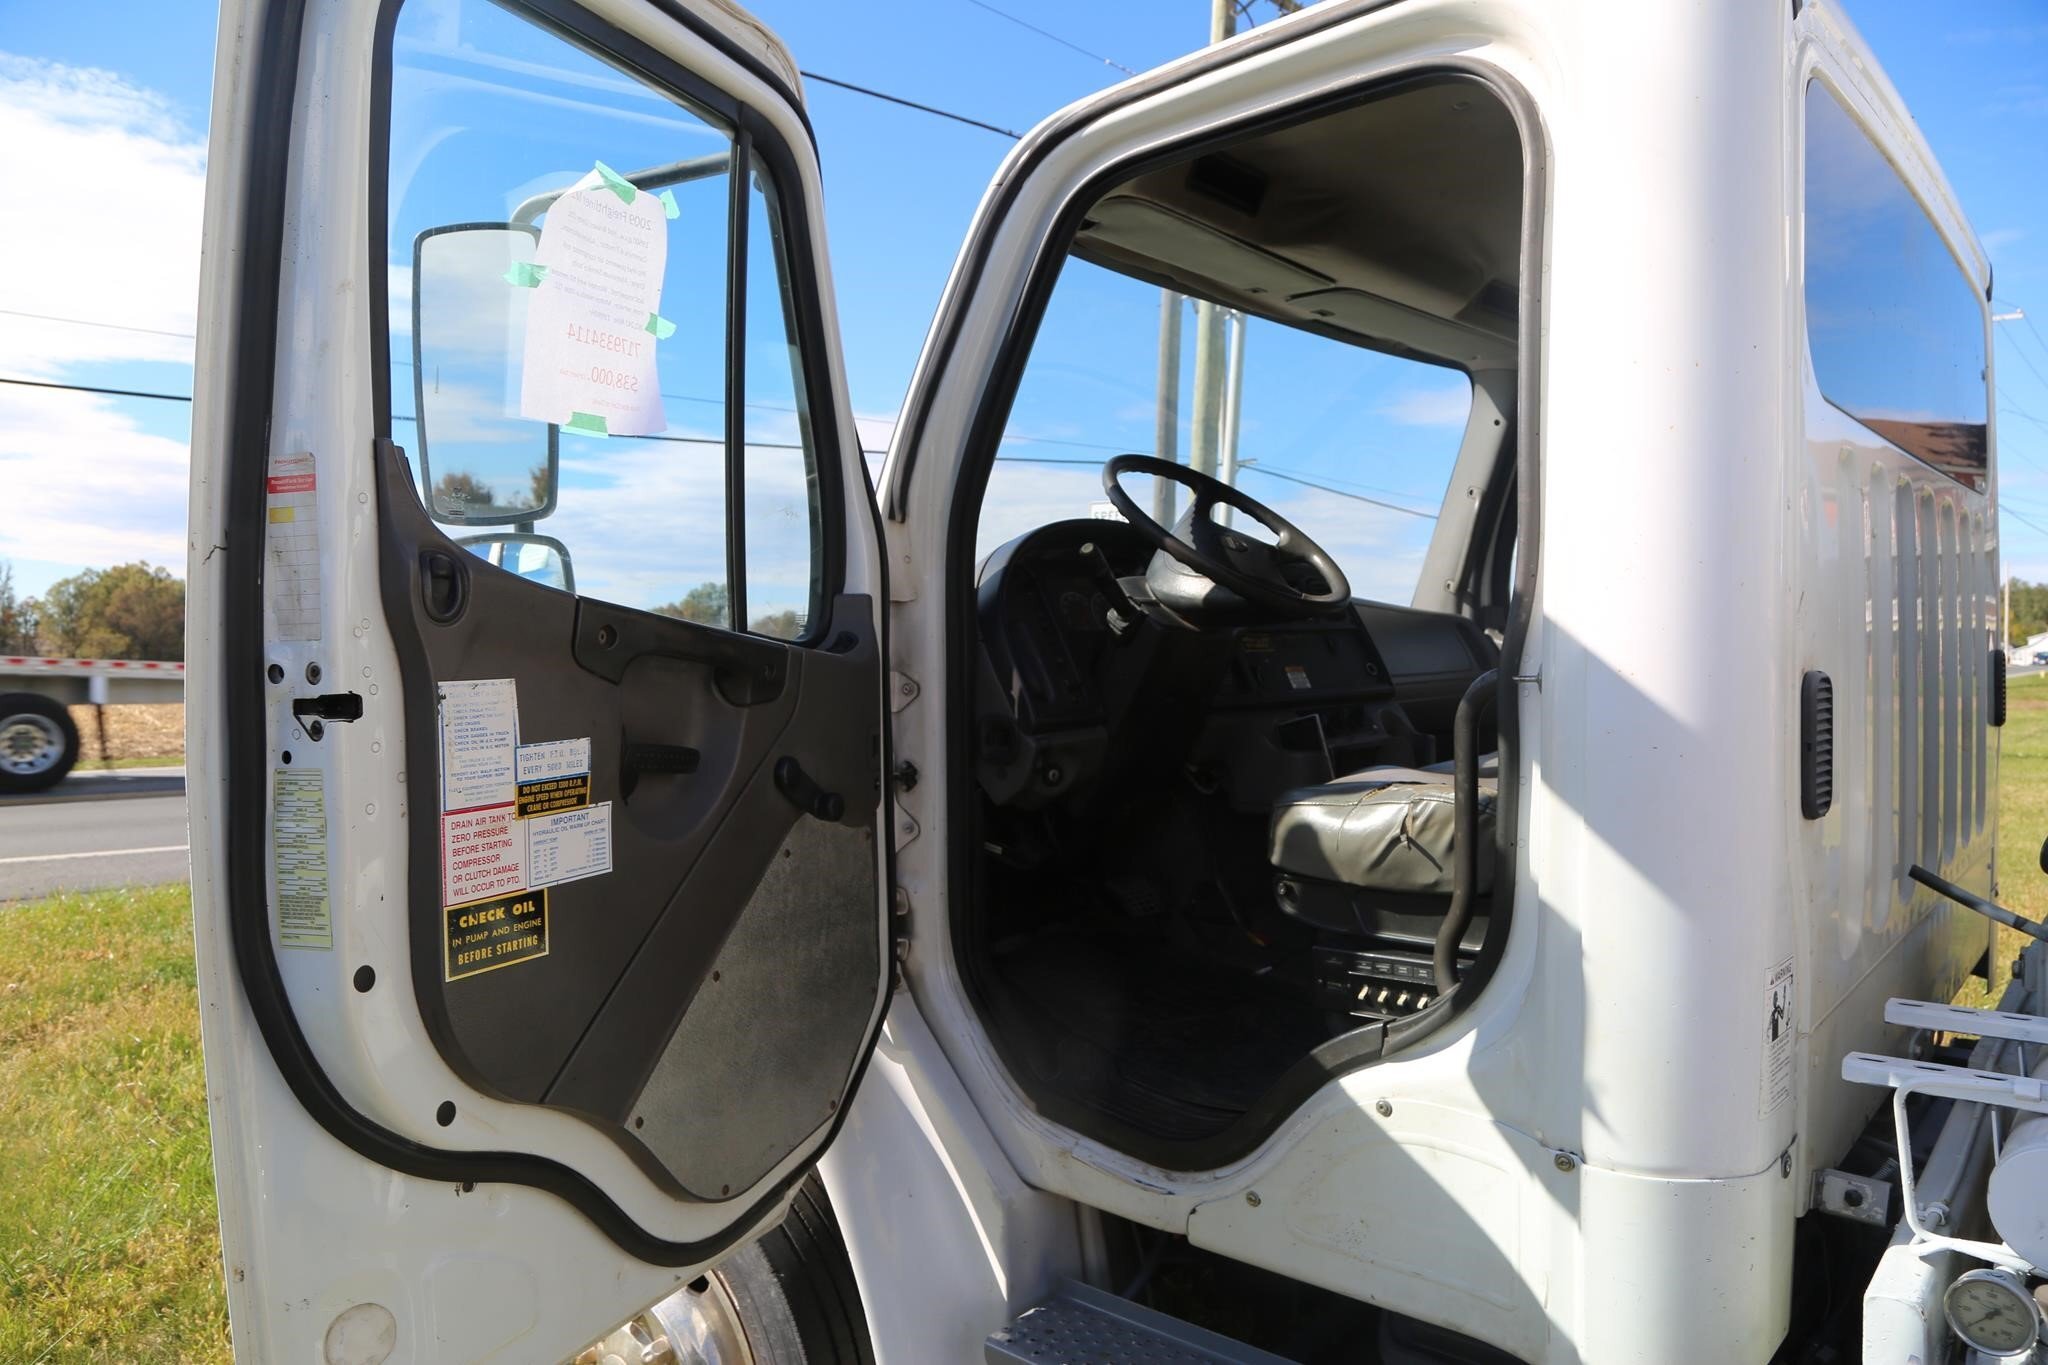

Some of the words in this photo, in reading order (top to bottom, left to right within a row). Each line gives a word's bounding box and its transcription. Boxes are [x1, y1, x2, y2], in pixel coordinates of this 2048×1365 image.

[520, 752, 545, 762] TIGHTEN
[524, 765, 542, 774] EVERY
[531, 784, 540, 792] NOT
[542, 782, 557, 791] EXCEED
[519, 795, 535, 804] ENGINE
[536, 793, 549, 801] SPEED
[564, 787, 586, 796] OPERATING
[527, 802, 541, 812] CRANE
[451, 820, 472, 830] DRAIN
[476, 817, 486, 825] AIR
[489, 814, 505, 823] TANK
[551, 813, 590, 826] IMPORTANT
[452, 833, 470, 843] ZERO
[473, 826, 508, 839] PRESSURE
[532, 827, 560, 836] HYDRAULIC
[453, 844, 480, 857] BEFORE
[482, 839, 512, 851] STARTING
[453, 854, 500, 870] COMPRESSOR
[453, 875, 462, 884] OR
[465, 869, 491, 881] CLUTCH
[493, 863, 519, 875] DAMAGE
[453, 886, 469, 896] WILL
[471, 881, 494, 893] OCCUR
[459, 907, 505, 928] CHECK
[512, 901, 535, 915] OIL
[452, 937, 462, 946] IN
[466, 931, 488, 943] PUMP
[492, 926, 510, 937] AND
[513, 918, 542, 931] ENGINE
[458, 947, 493, 965] BEFORE
[496, 935, 538, 955] STARTING
[1775, 963, 1792, 981] WARNING
